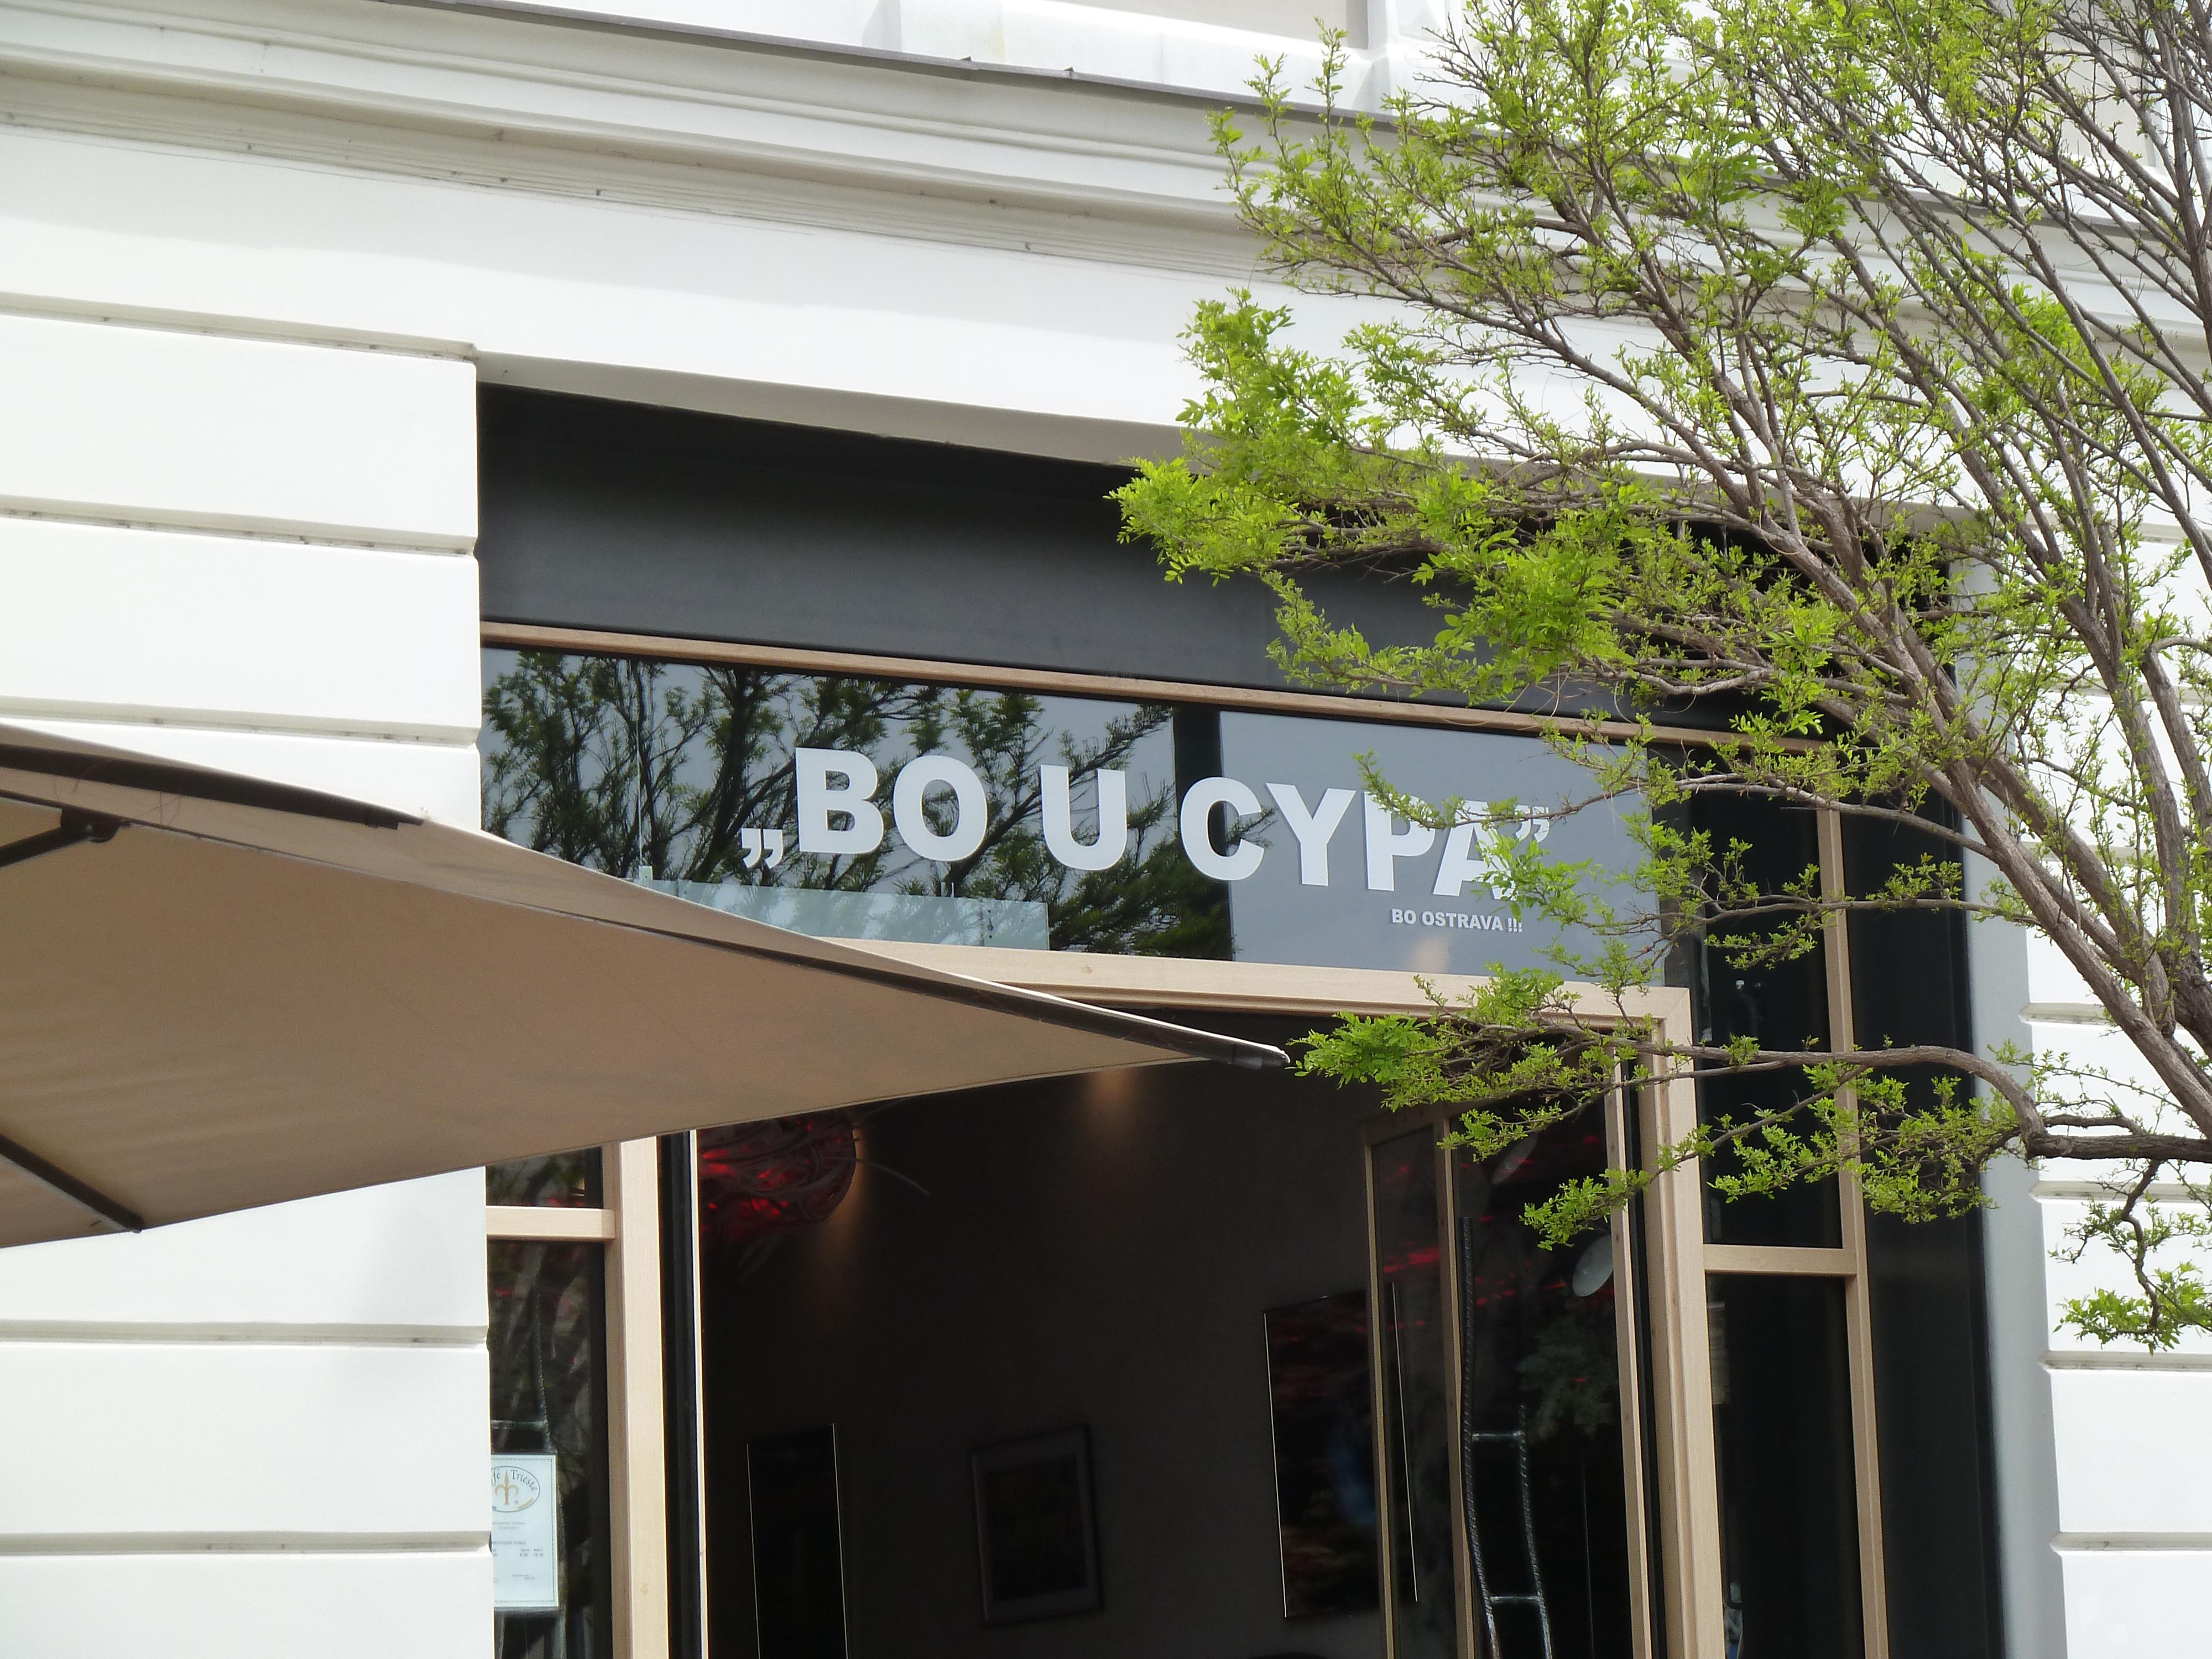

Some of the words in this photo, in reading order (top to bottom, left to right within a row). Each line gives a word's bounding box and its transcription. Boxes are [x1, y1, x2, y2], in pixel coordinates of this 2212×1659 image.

[1041, 764, 1128, 870] U
[1391, 909, 1416, 925] BO
[1422, 911, 1504, 931] OSTRAVA
